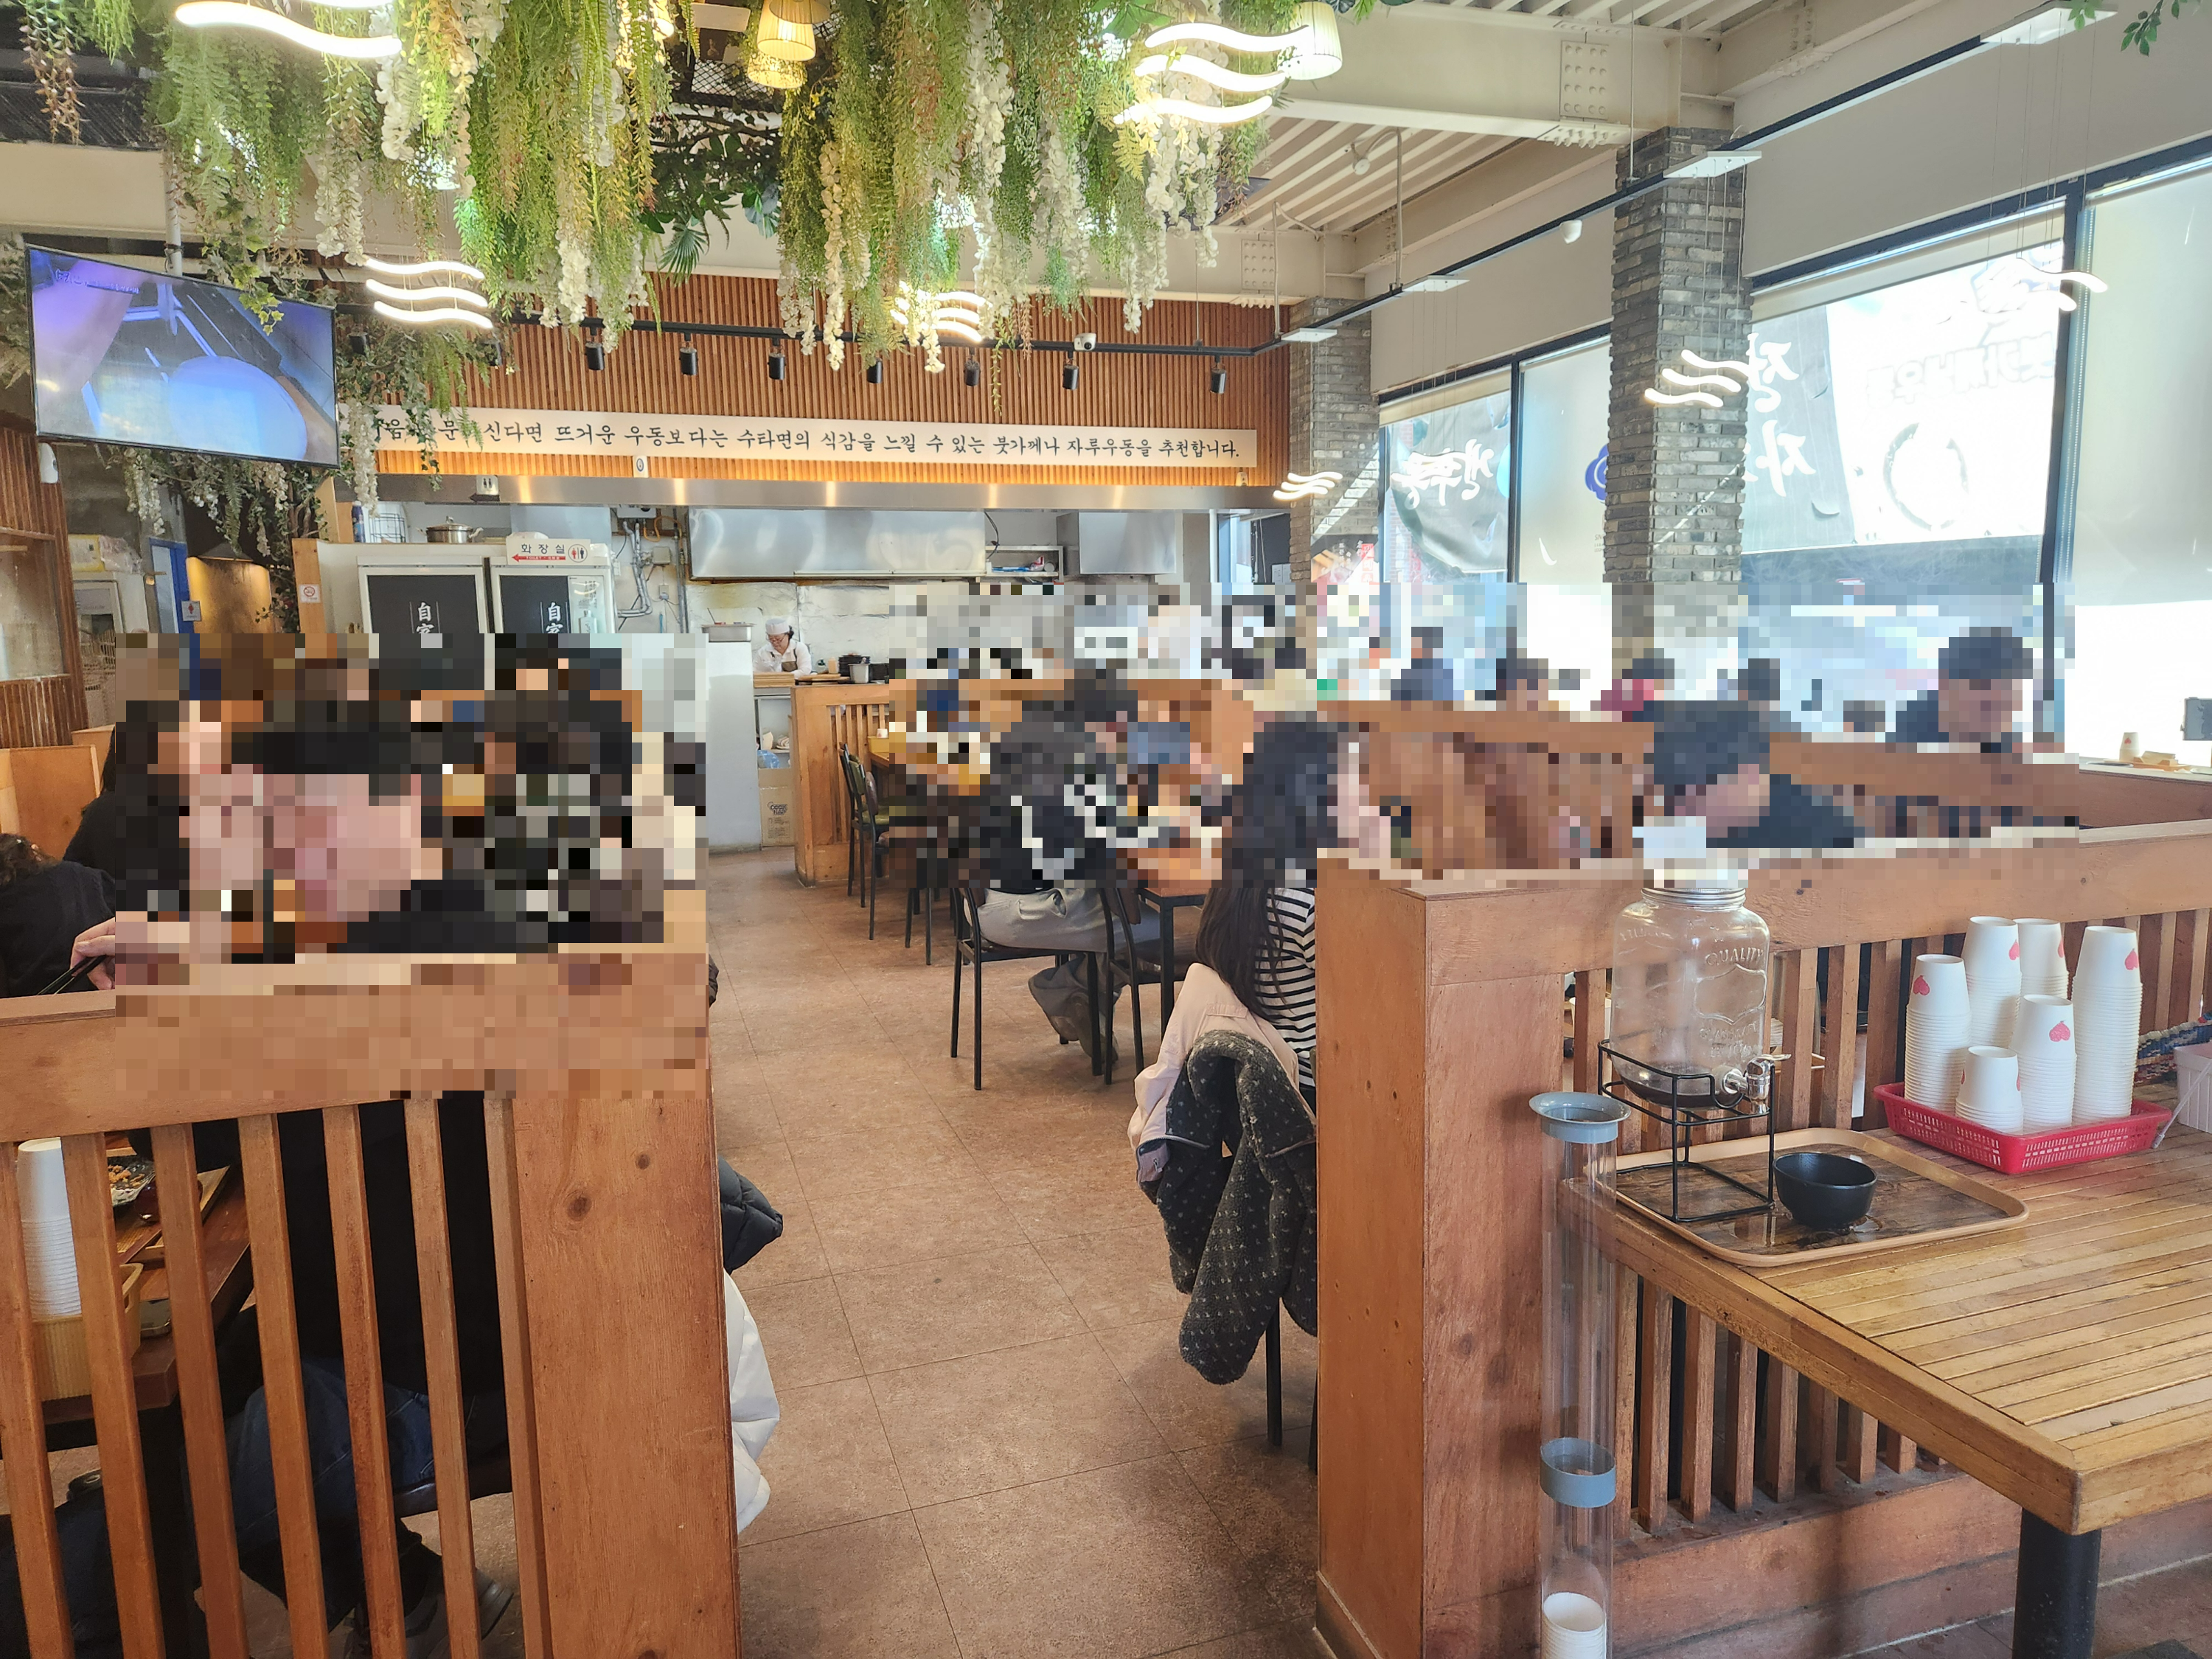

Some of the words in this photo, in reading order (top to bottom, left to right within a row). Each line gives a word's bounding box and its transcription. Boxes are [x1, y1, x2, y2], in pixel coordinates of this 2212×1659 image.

[418, 417, 542, 442] 문신다면
[555, 423, 616, 445] 뜨거운
[625, 425, 728, 448] 우동보다는
[737, 428, 810, 451] 수타면의
[821, 431, 876, 452] 식감을
[884, 433, 916, 453] 느낄
[926, 434, 944, 453] 수
[953, 434, 985, 454] 있는
[992, 436, 1060, 456] 붓가께나
[1066, 437, 1152, 457] 자루우동을
[1158, 439, 1239, 459] 추천합니다.
[1705, 947, 1764, 967] QUALITY
